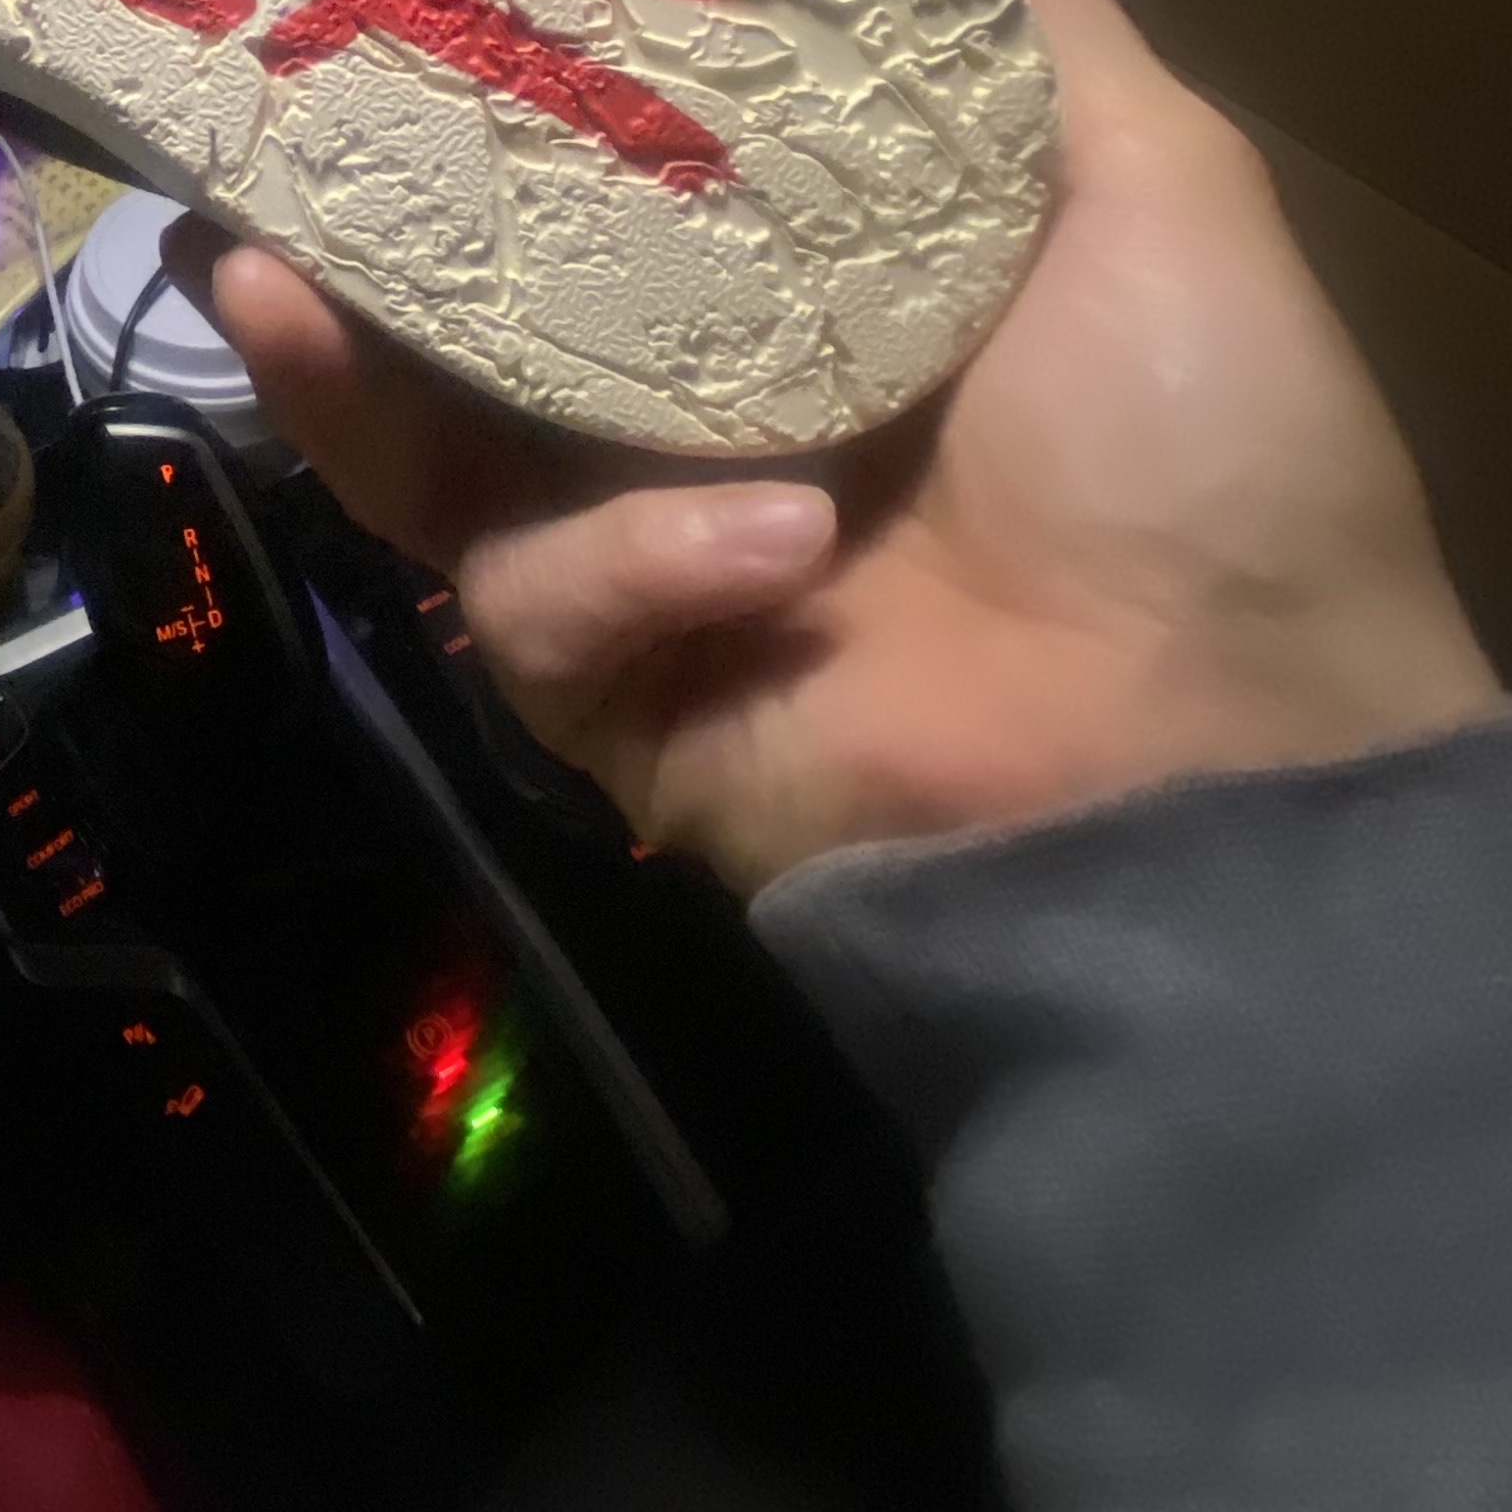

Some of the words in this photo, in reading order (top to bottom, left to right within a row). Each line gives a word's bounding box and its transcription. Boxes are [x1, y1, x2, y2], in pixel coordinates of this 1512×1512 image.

[161, 464, 174, 484] P
[183, 528, 198, 548] R
[194, 564, 211, 584] N
[207, 610, 223, 629] D
[156, 621, 188, 642] M/S
